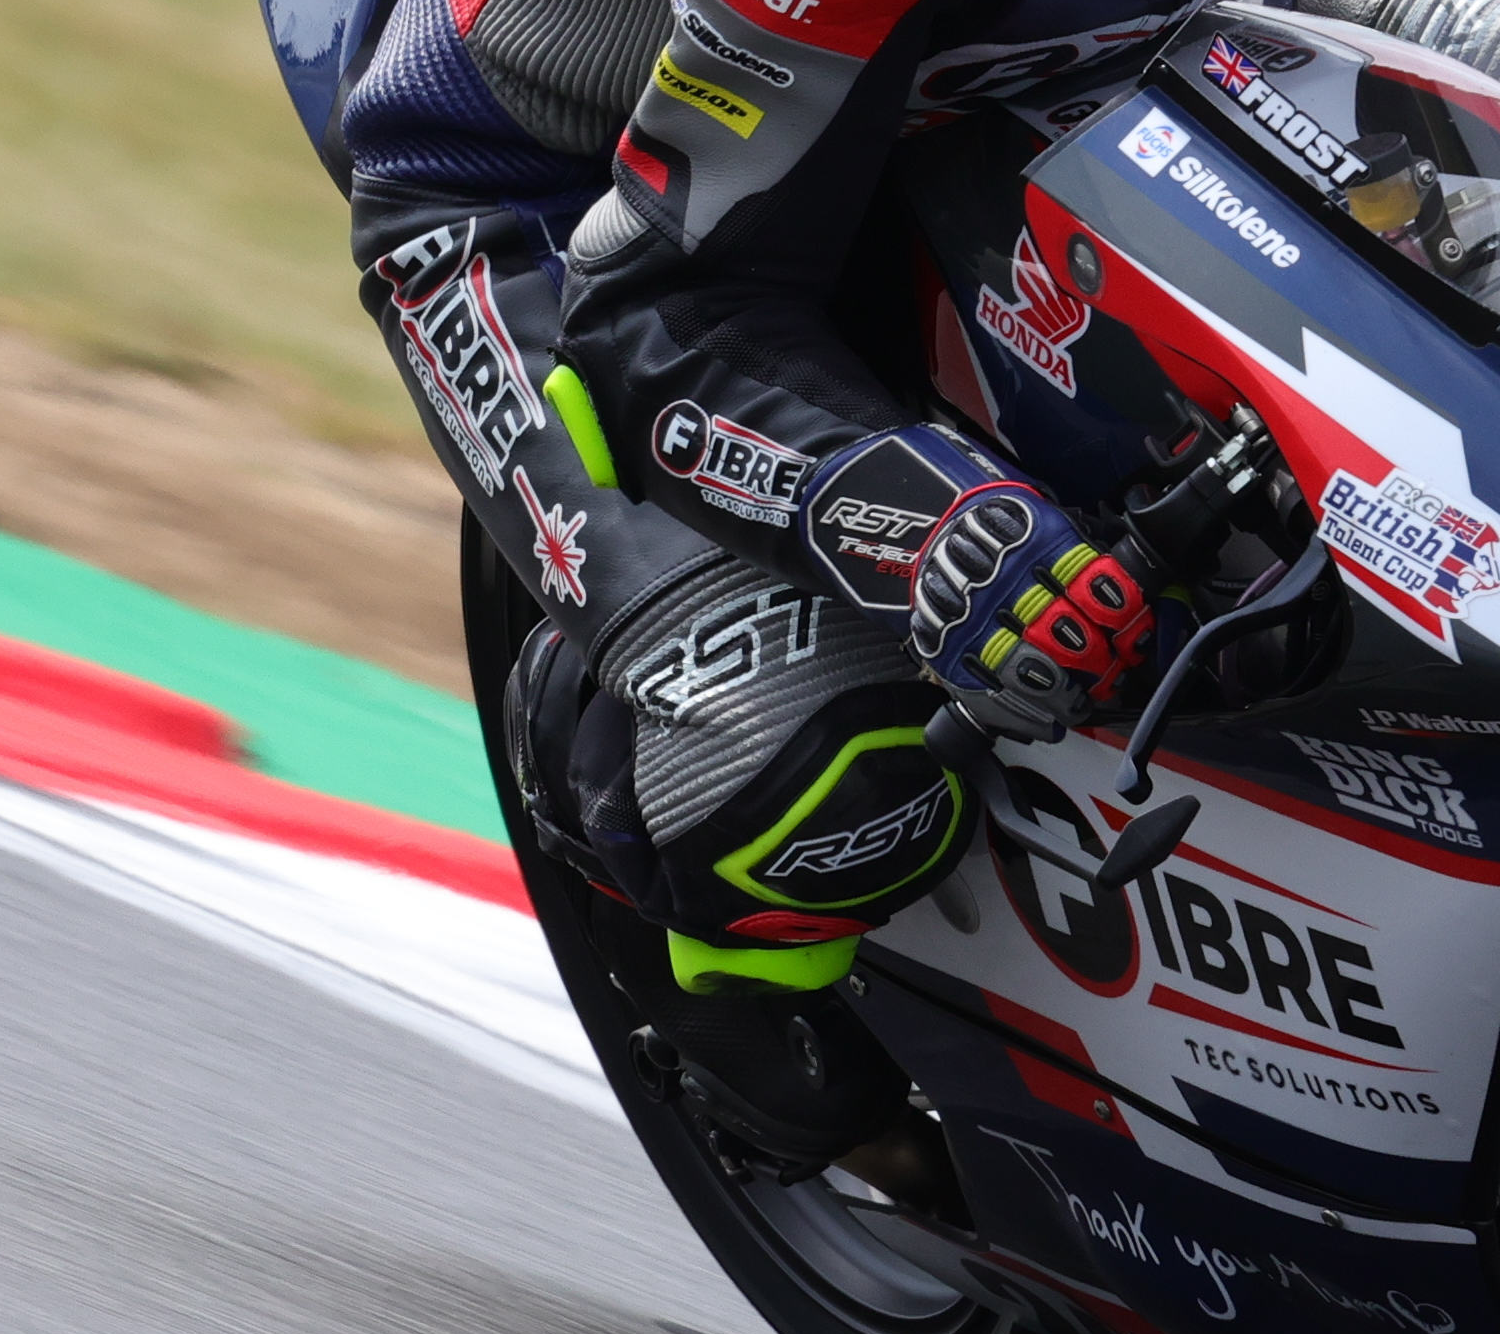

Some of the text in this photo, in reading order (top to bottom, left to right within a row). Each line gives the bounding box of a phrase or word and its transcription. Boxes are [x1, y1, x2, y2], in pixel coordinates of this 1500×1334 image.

[684, 13, 791, 85] Silkolene
[659, 62, 748, 119] UNLOP
[1240, 79, 1369, 187] FROST
[1137, 127, 1301, 270] FUCHS Silkolene
[978, 293, 1076, 390] HONDA
[656, 407, 807, 500] FIBRE
[820, 497, 940, 539] RST
[1324, 476, 1444, 565] British
[1382, 476, 1444, 522] R&G
[1322, 516, 1429, 593] Talent Cup
[1280, 730, 1453, 786] KING
[1311, 758, 1479, 831] DICK
[765, 782, 952, 878] RST
[1418, 818, 1484, 849] TOOLS
[1025, 797, 1406, 1051] FIBRE
[1184, 1037, 1242, 1077] TEC
[977, 1125, 1162, 1265] Thank
[1174, 1234, 1261, 1321] you
